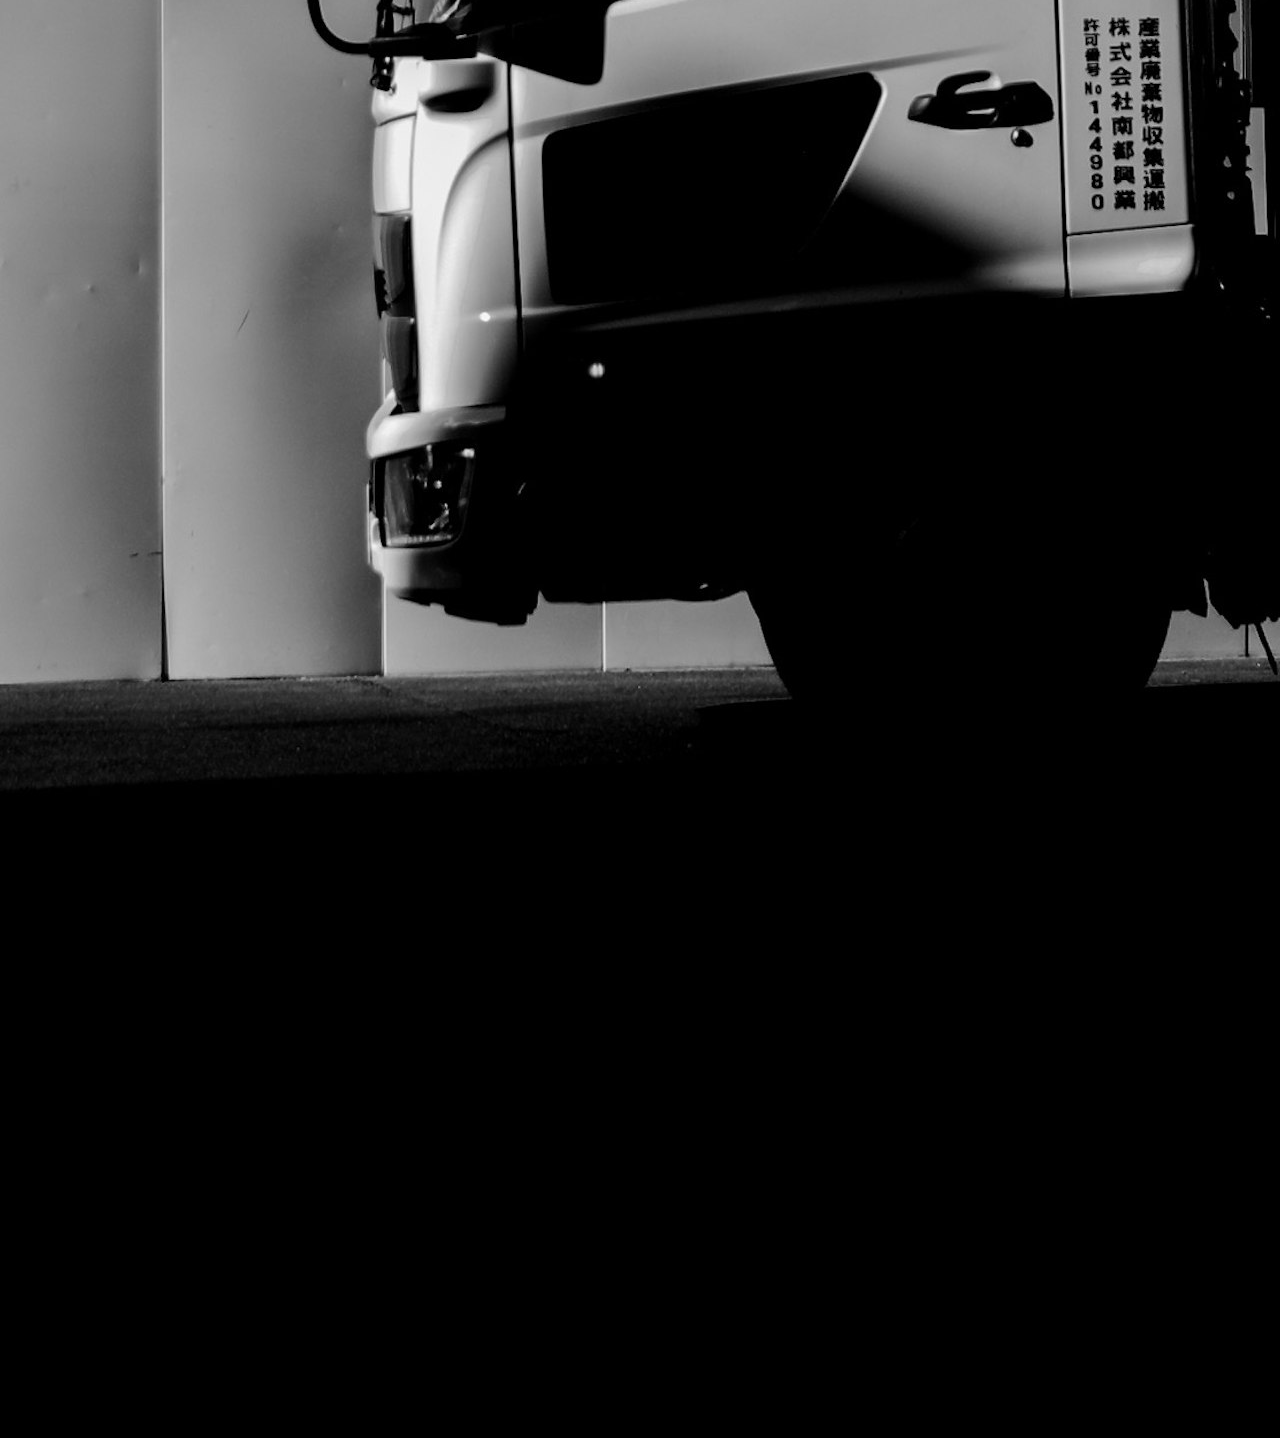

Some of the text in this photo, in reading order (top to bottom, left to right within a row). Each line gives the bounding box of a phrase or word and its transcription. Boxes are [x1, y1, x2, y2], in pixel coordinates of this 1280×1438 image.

[1108, 16, 1136, 210] 株式会社南都興業
[1138, 16, 1166, 212] 産業廃棄物収集運搬
